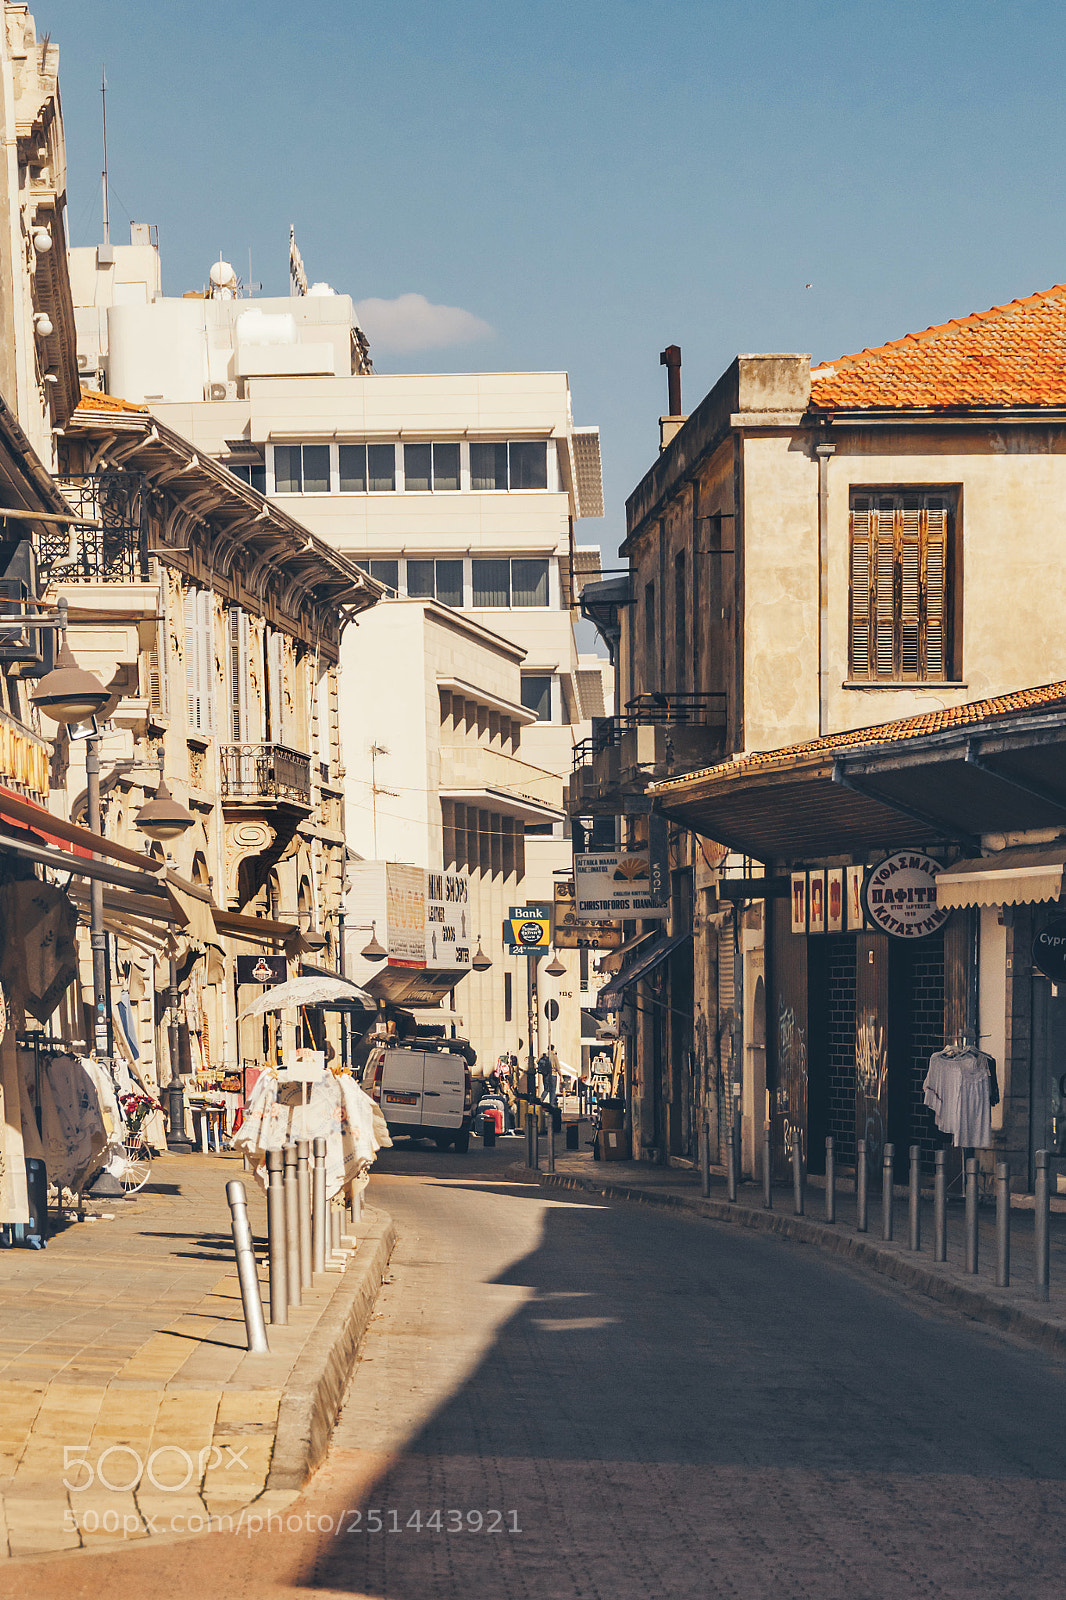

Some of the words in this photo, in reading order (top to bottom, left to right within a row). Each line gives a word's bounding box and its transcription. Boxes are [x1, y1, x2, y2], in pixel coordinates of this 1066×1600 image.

[872, 856, 941, 886] ΥΦΑΣΜΑΤ
[445, 875, 468, 904] SHOPS
[872, 887, 937, 903] ΠΑΦΙΤΗ
[515, 908, 543, 918] Bank
[579, 899, 630, 911] CHRISTOFOROS
[442, 925, 456, 942] GOODS
